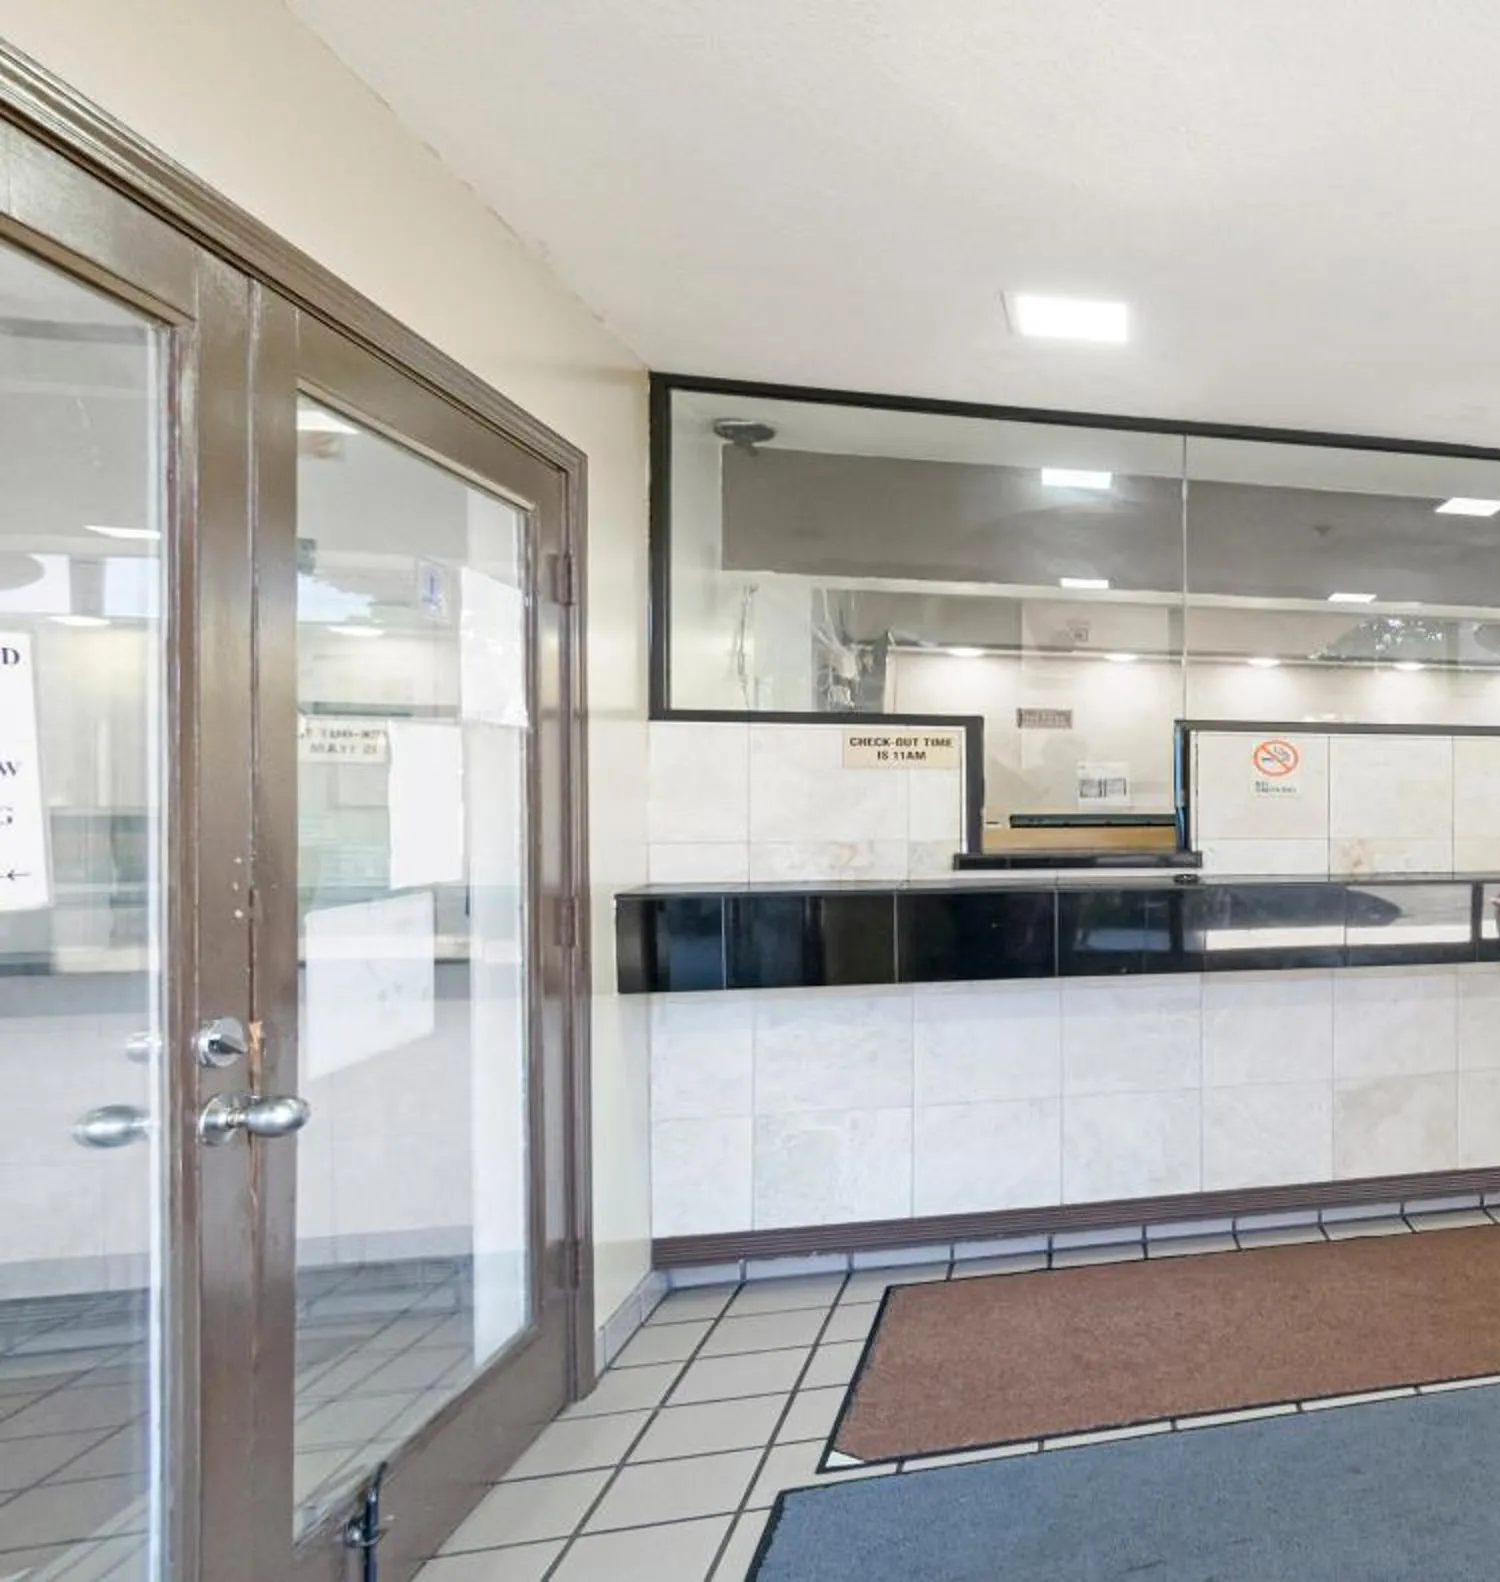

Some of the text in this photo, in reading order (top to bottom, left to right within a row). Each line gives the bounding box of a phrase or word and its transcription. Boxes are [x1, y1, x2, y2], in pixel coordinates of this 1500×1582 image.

[849, 737, 952, 748] CHECK-OUT TIME
[877, 751, 927, 761] IS 11AM
